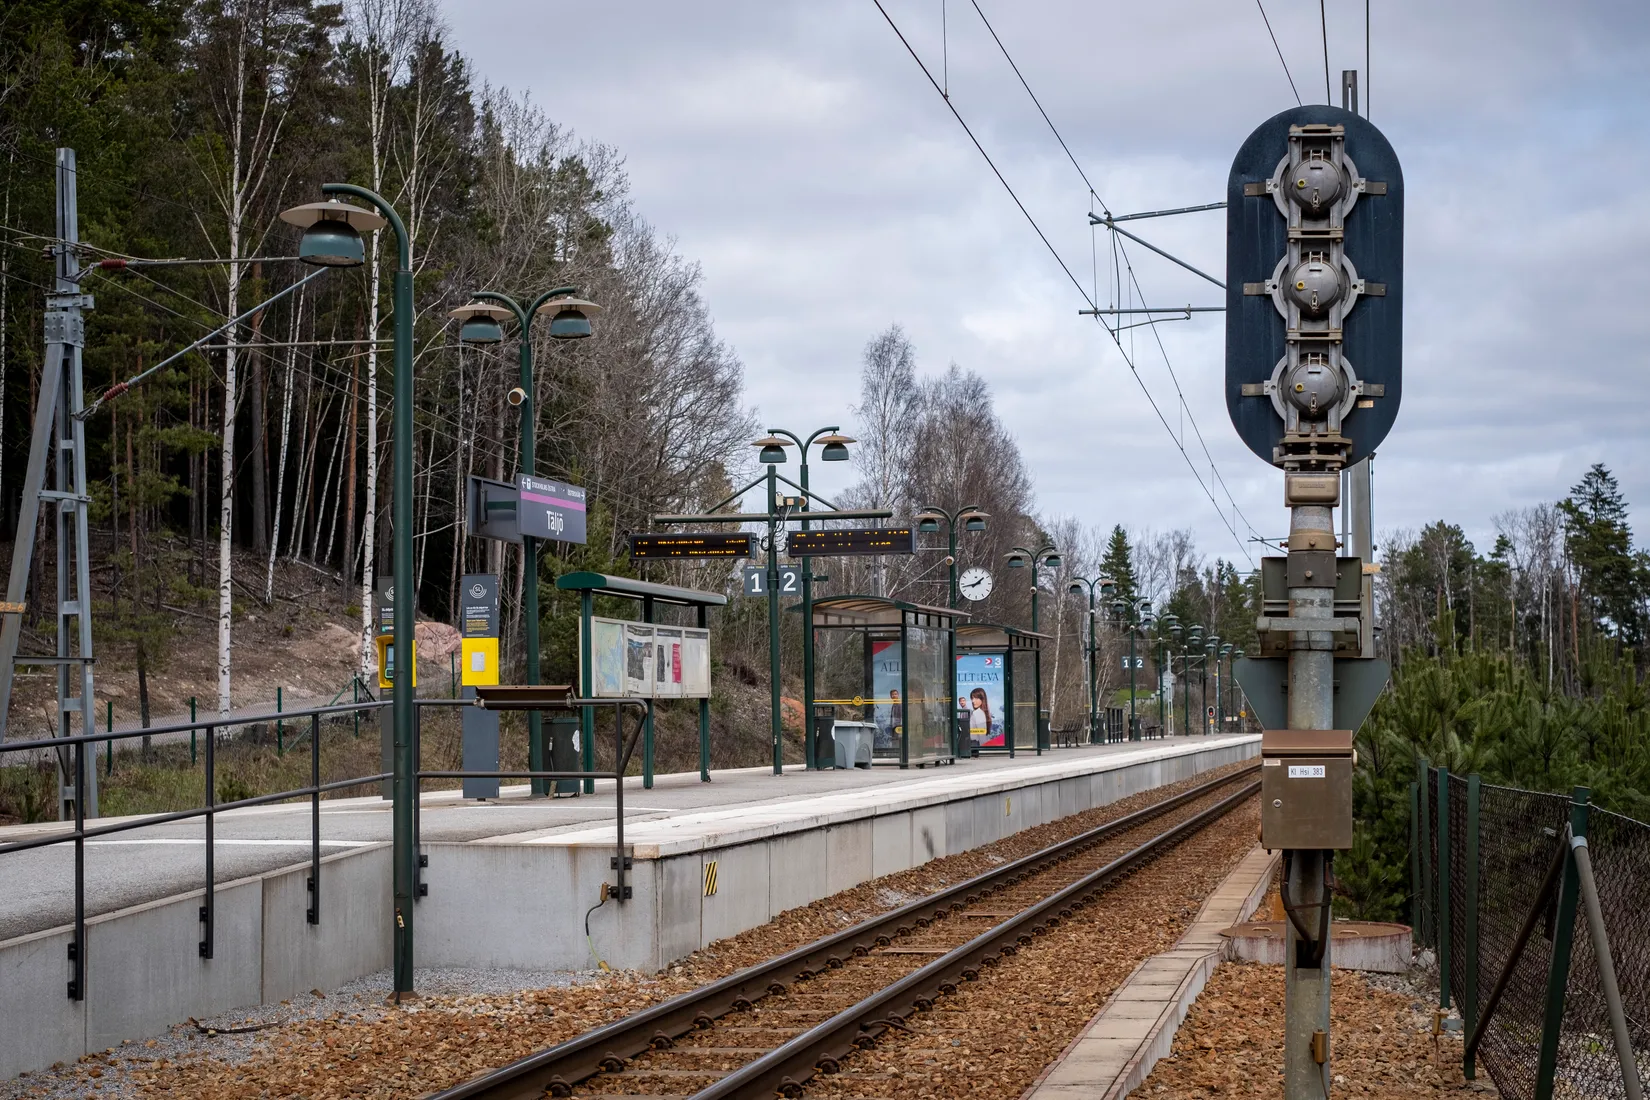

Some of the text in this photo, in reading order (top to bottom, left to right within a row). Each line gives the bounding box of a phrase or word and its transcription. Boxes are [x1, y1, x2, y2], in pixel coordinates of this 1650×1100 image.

[546, 510, 564, 536] Täljö
[751, 572, 762, 592] 1
[783, 572, 796, 592] 2
[995, 657, 1001, 666] 3
[1124, 659, 1129, 668] 1
[1137, 659, 1143, 668] 2
[980, 672, 999, 682] EVA
[1300, 768, 1310, 776] Hsi
[1313, 768, 1323, 776] 383
